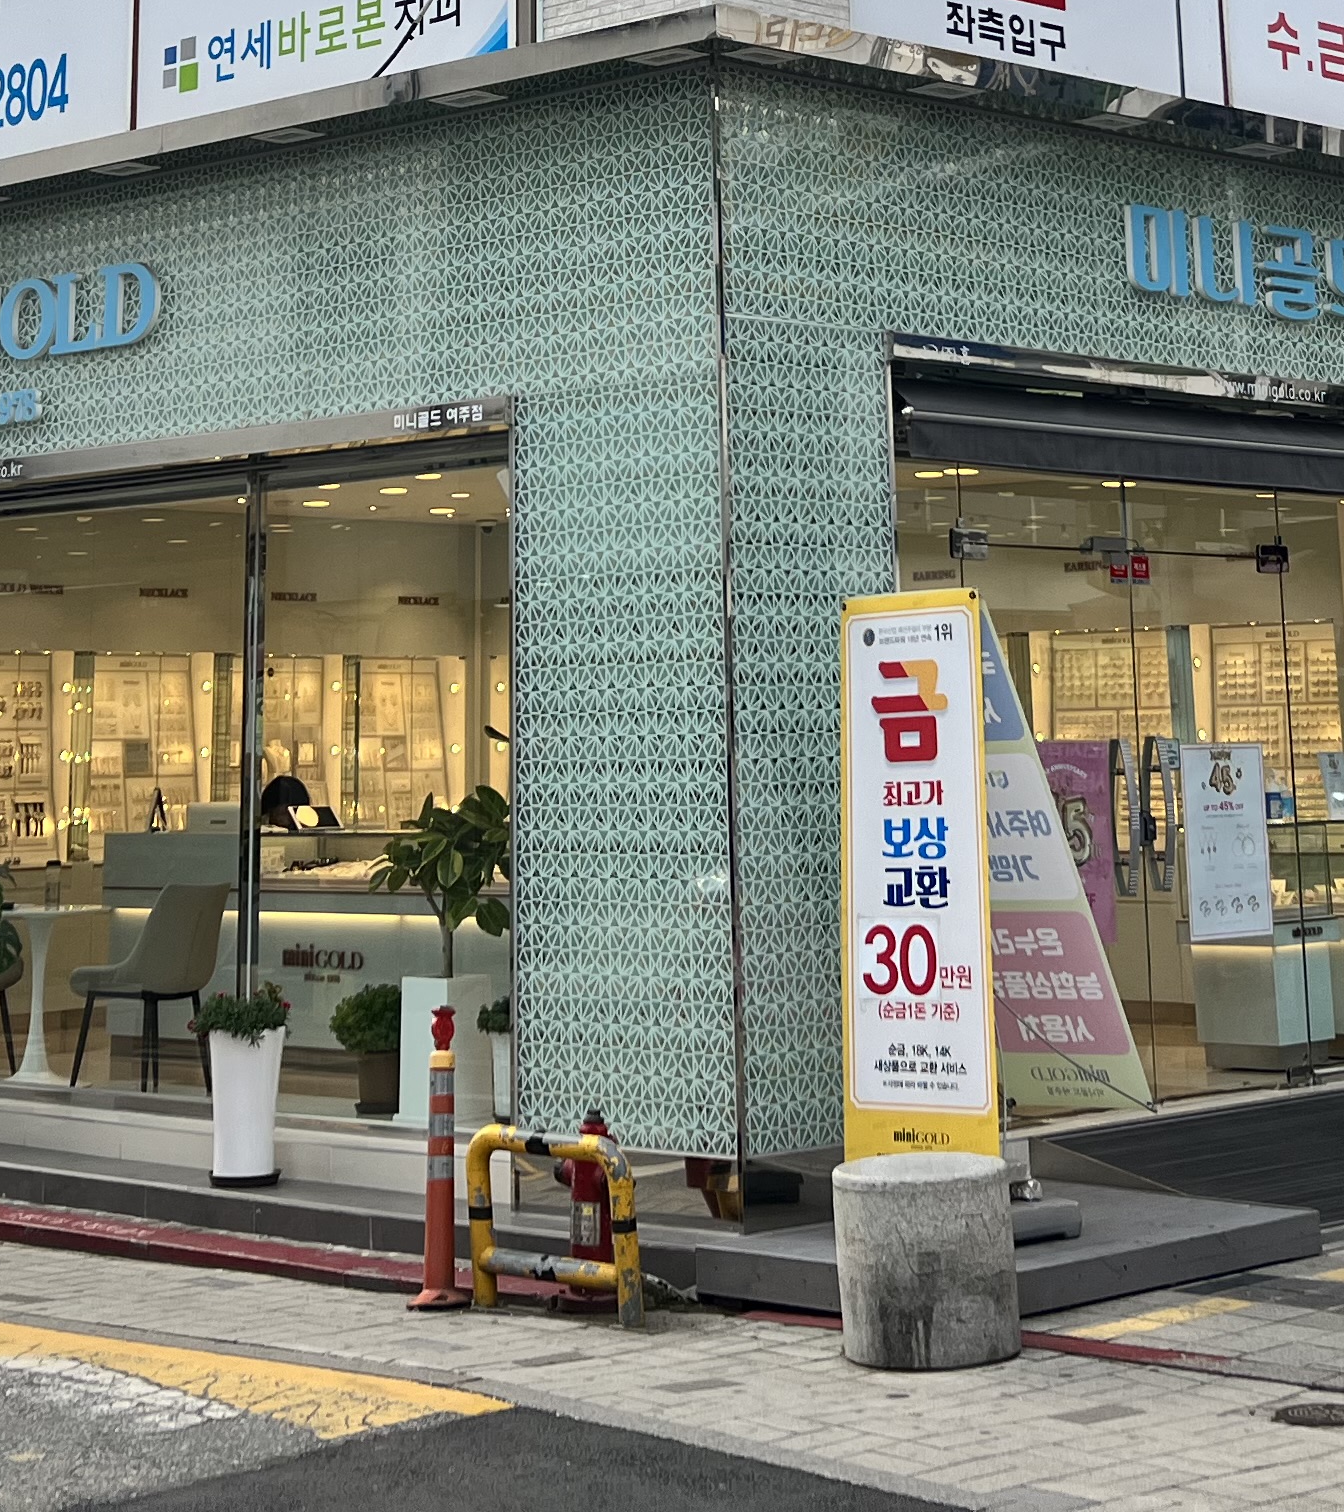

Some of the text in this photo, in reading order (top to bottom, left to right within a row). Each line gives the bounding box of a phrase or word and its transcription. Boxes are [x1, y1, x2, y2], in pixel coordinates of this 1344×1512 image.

[945, 0, 1067, 62] 좌측입구
[394, 404, 483, 430] 미니골드 여주점
[913, 570, 955, 581] EARRING
[934, 623, 953, 642] 1위
[871, 659, 949, 763] 금
[883, 780, 944, 807] 최고가
[882, 817, 949, 860] 보상
[882, 865, 951, 909] 교환
[282, 943, 364, 970] miniGOLD
[920, 1062, 938, 1075] 교환
[940, 1062, 967, 1075] 서비스
[893, 1128, 950, 1145] miniGOLD
